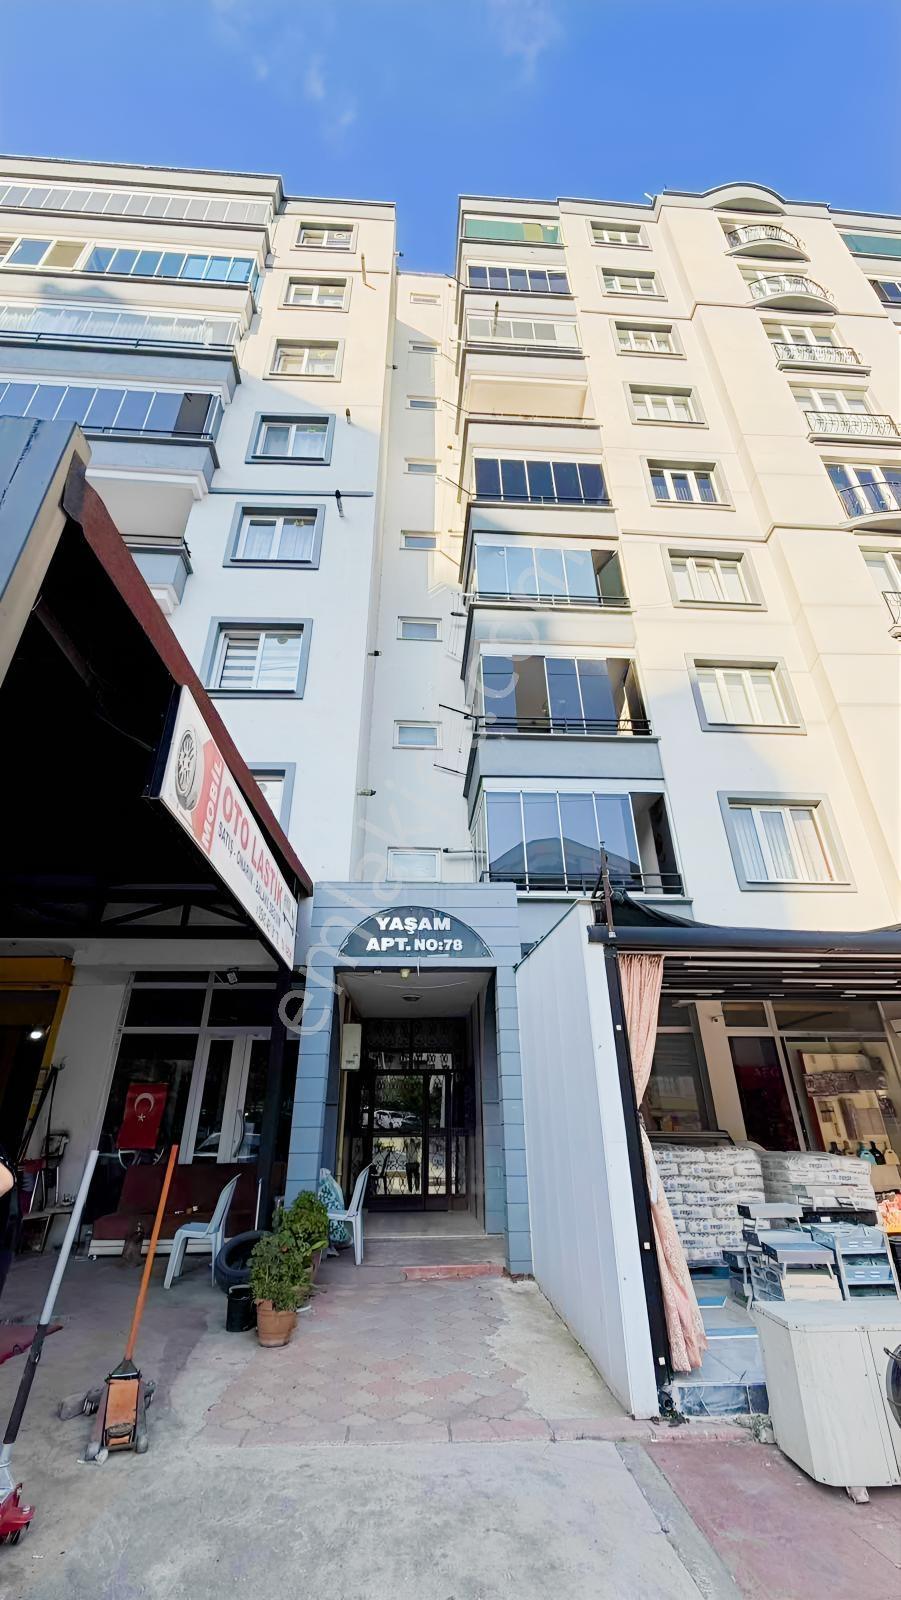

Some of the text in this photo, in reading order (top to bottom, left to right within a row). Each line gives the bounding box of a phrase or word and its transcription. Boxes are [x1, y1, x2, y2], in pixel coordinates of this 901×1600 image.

[222, 786, 249, 851] OTO
[375, 917, 451, 935] YAŞAM
[366, 937, 463, 952] APT. NO:78
